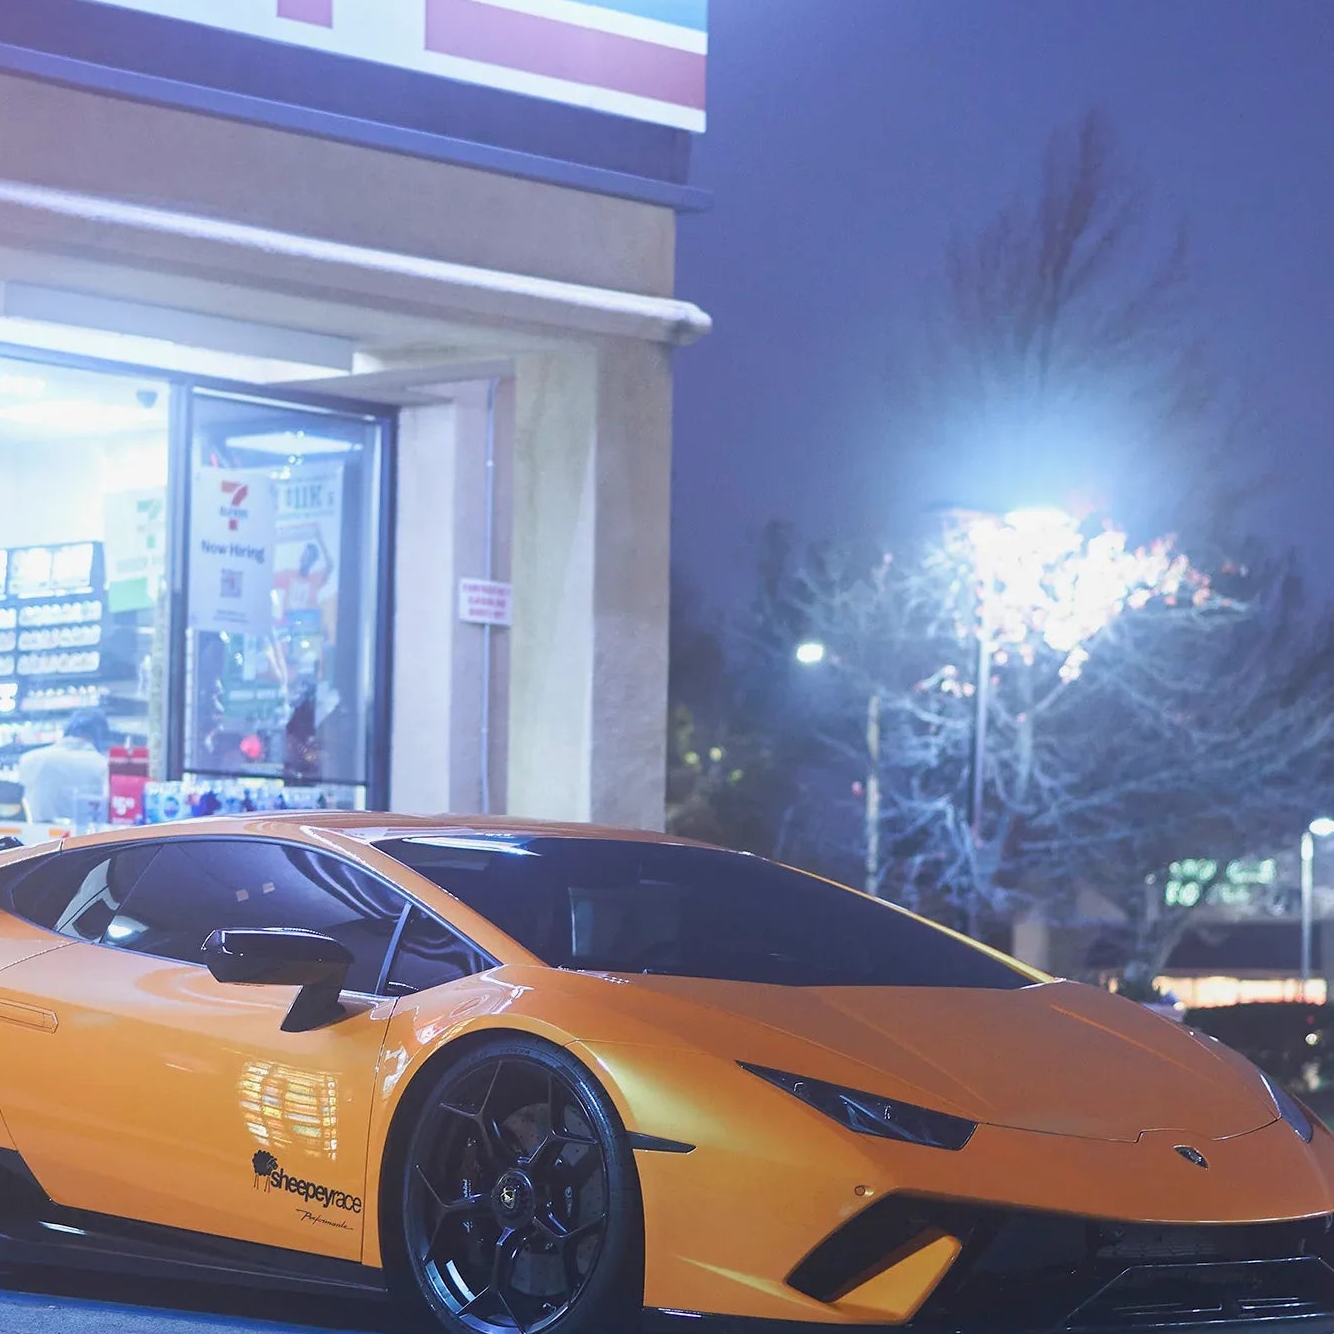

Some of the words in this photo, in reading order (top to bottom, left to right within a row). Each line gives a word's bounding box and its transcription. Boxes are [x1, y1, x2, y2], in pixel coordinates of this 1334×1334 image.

[221, 480, 248, 531] 7
[201, 539, 227, 556] Now
[229, 541, 265, 564] Hiring
[271, 1168, 362, 1214] sheepeyrace
